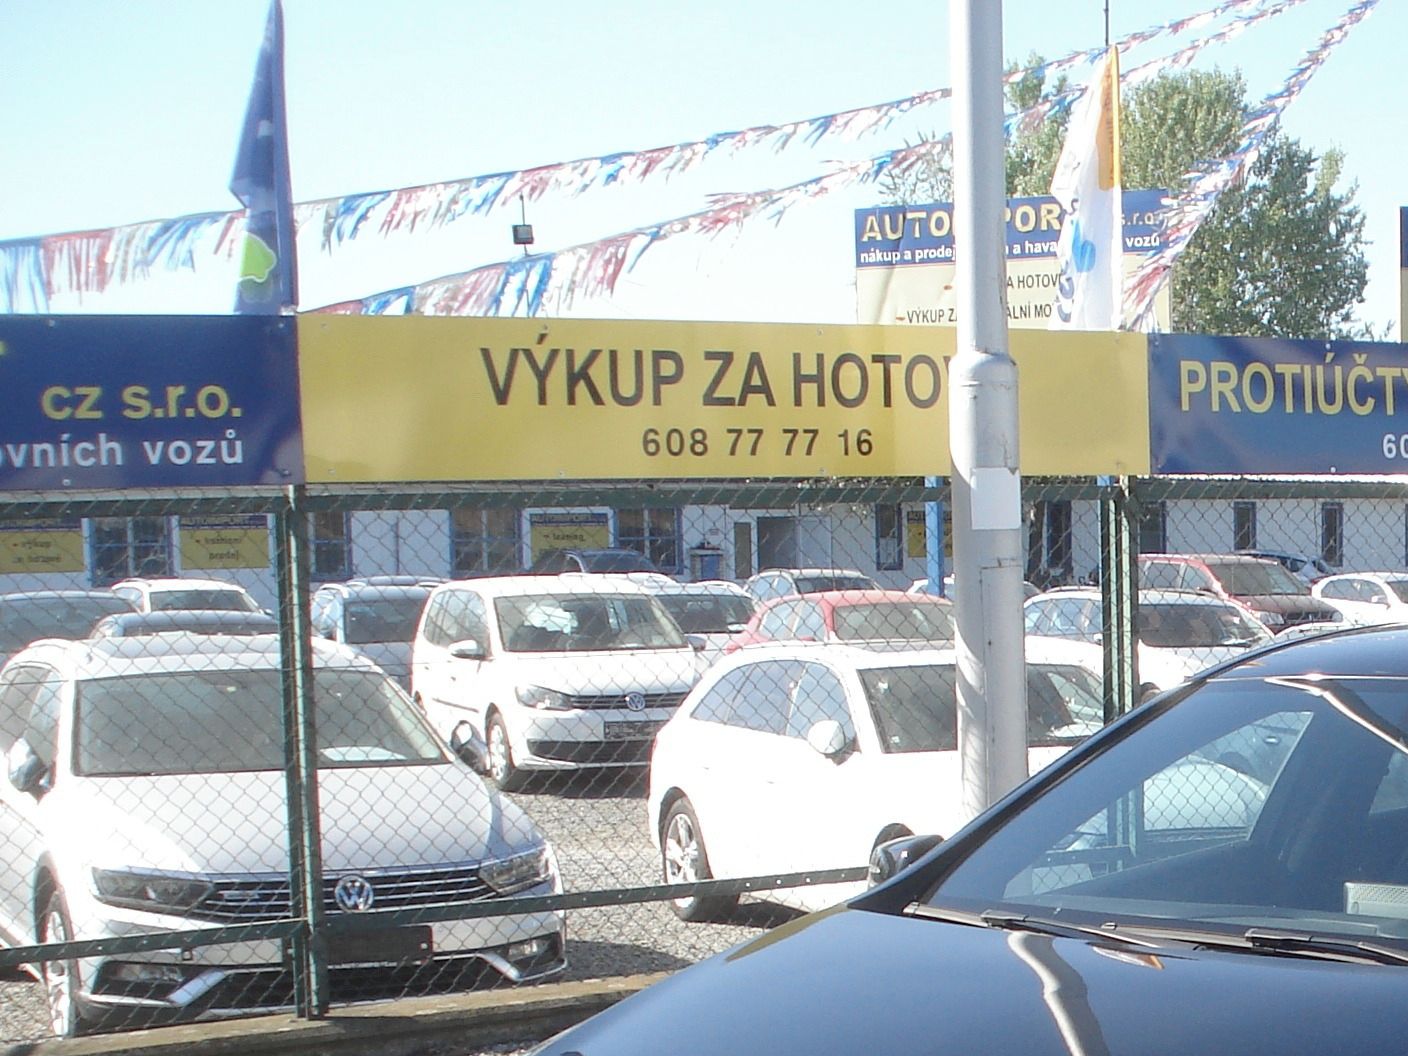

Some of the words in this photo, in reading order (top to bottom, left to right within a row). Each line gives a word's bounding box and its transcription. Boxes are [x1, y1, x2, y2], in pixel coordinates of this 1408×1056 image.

[860, 248, 900, 263] nákup
[904, 250, 912, 260] a
[1017, 273, 1061, 289] HOTOV
[907, 306, 945, 323] VÝKUP
[480, 332, 686, 407] VÝKUP
[703, 351, 777, 407] ZA
[793, 352, 951, 409] HOTO
[41, 385, 104, 420] cz
[122, 385, 243, 419] s.r.o.
[0, 433, 124, 468] vních
[143, 429, 243, 465] vozů
[643, 428, 709, 457] 608
[727, 428, 764, 457] 77
[782, 428, 819, 457] 77
[837, 428, 873, 457] 16
